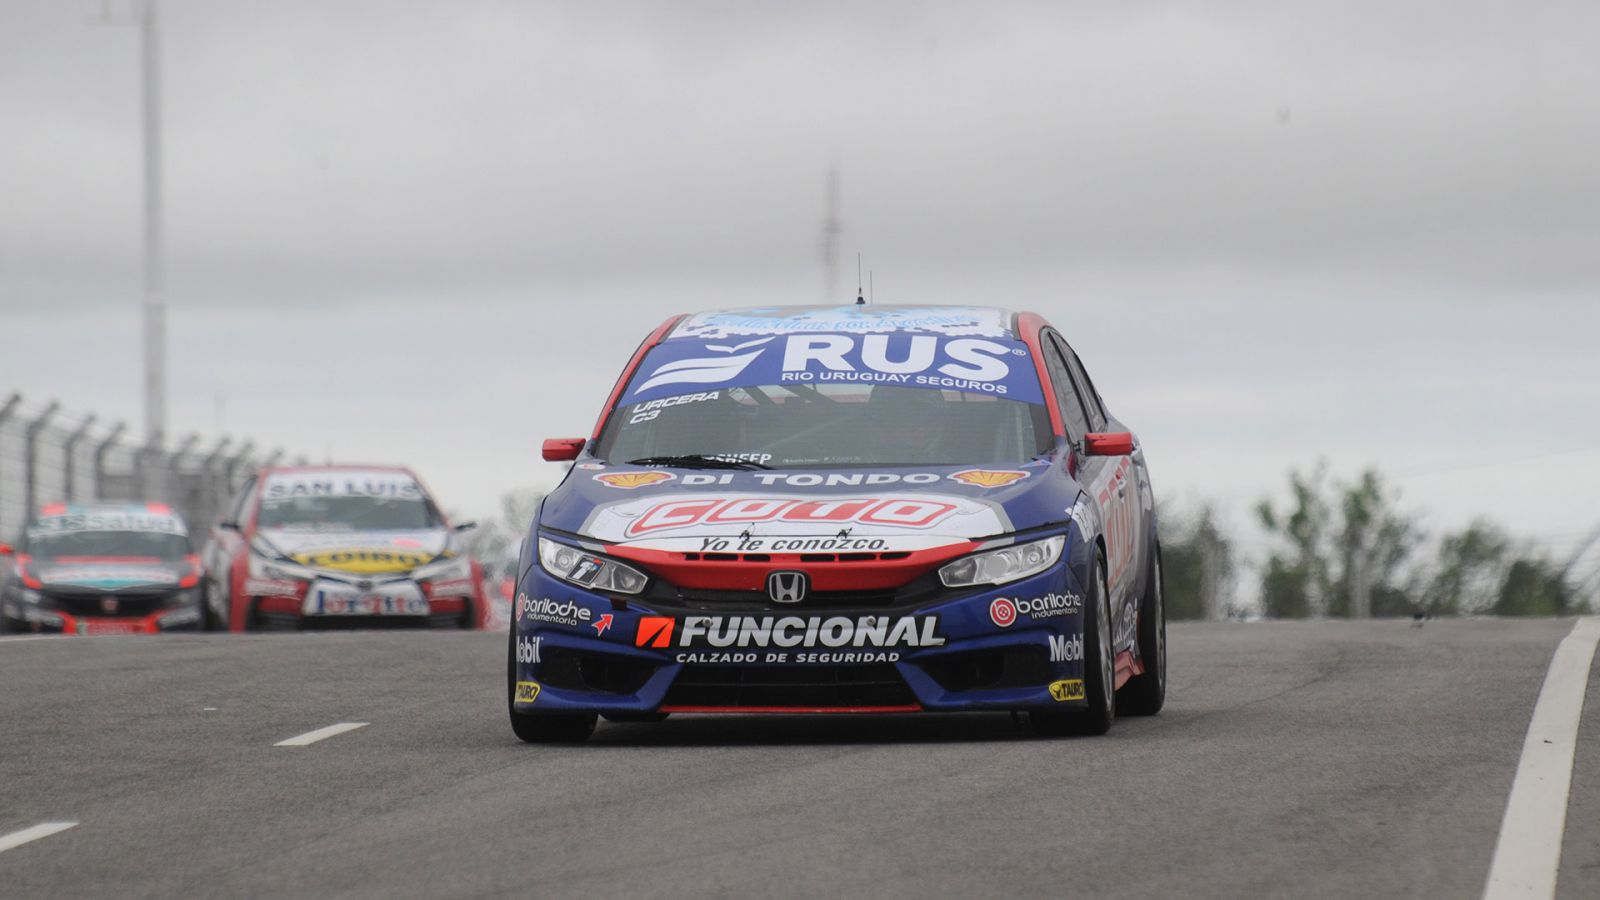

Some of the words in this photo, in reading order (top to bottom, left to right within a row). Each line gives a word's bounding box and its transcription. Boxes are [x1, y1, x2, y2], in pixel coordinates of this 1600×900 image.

[781, 372, 814, 382] RIO
[819, 372, 911, 384] URUGUAY
[915, 374, 1008, 395] SEGUROS
[632, 391, 721, 414] URCERA
[270, 480, 333, 497] SAN
[345, 480, 417, 497] LUIS
[681, 473, 734, 485] DI
[754, 473, 940, 486] TONDO
[629, 499, 960, 535] COTO
[700, 537, 729, 551] Yo
[737, 538, 764, 550] te
[771, 538, 890, 550] conozco.
[524, 596, 591, 621] bariloche
[1015, 590, 1081, 614] bariloche
[1031, 607, 1078, 619] indumentaria
[679, 616, 946, 647] FUNCIONAL
[676, 653, 757, 663] CALZADO
[765, 653, 787, 662] DE
[796, 652, 900, 663] SEGURIDAD
